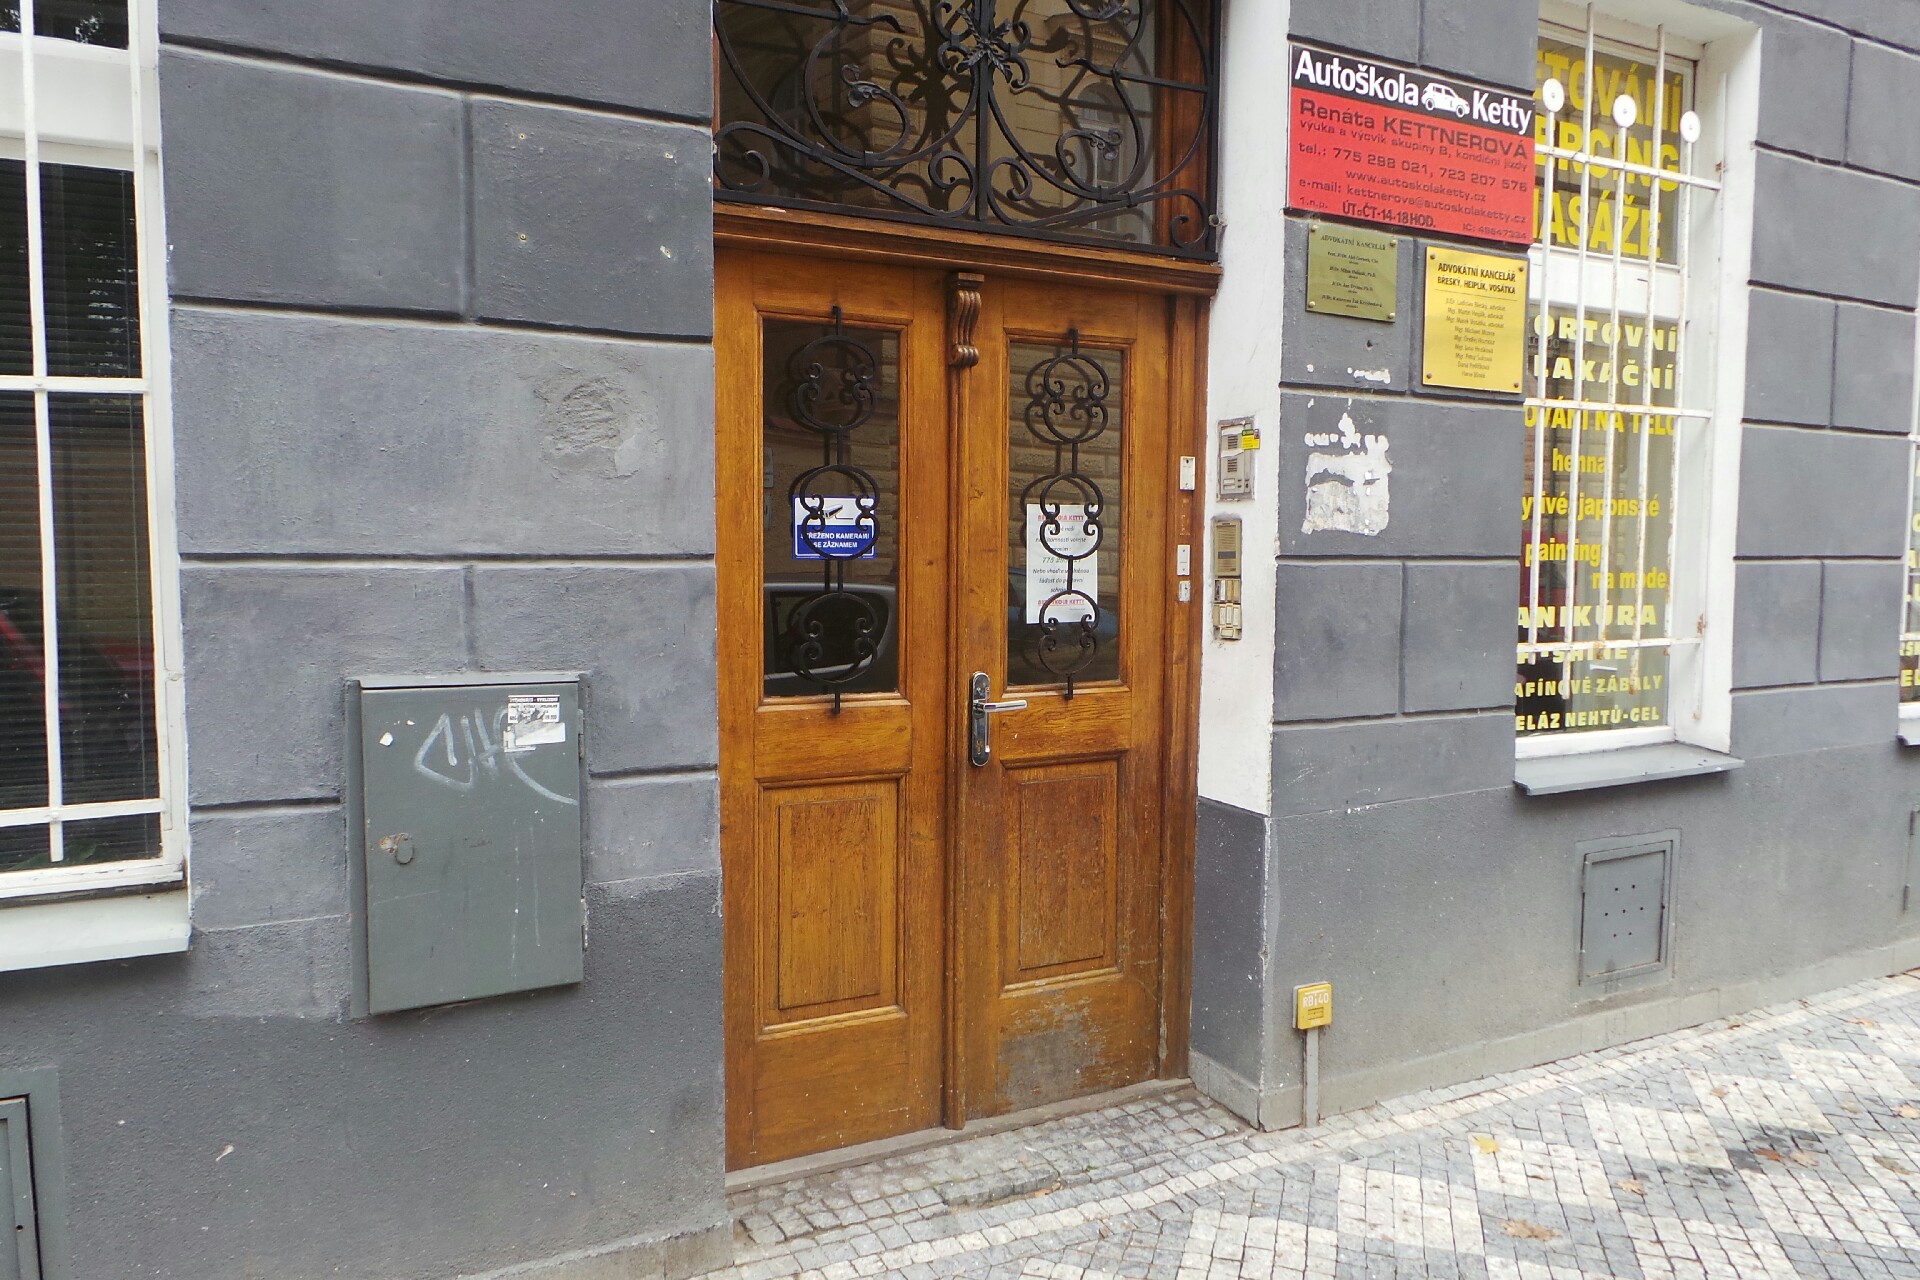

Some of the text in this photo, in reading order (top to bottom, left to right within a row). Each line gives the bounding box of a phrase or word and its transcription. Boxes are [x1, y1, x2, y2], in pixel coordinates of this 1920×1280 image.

[1294, 50, 1532, 135] Autoškola Ketty
[1300, 98, 1528, 159] Renáta KETTNEROVÁ
[1300, 118, 1335, 134] výuka
[1339, 128, 1346, 136] a
[1351, 129, 1386, 144] výcvik
[1391, 138, 1435, 155] skupiny
[1298, 142, 1326, 156] tel.:
[1332, 147, 1362, 163] 775
[1401, 160, 1433, 178] 021,
[1439, 167, 1466, 181] 723
[1471, 173, 1497, 187] 207
[1299, 178, 1527, 224] e-mail: kettnerova@autoskolaketty.cz
[1345, 170, 1486, 202] www.autoskolaketty.cz
[1437, 262, 1517, 282] ADVOKÁTNÍ KANCELÁŘ
[1552, 447, 1608, 474] henna
[1564, 704, 1660, 727] NEHTŮ-GEL
